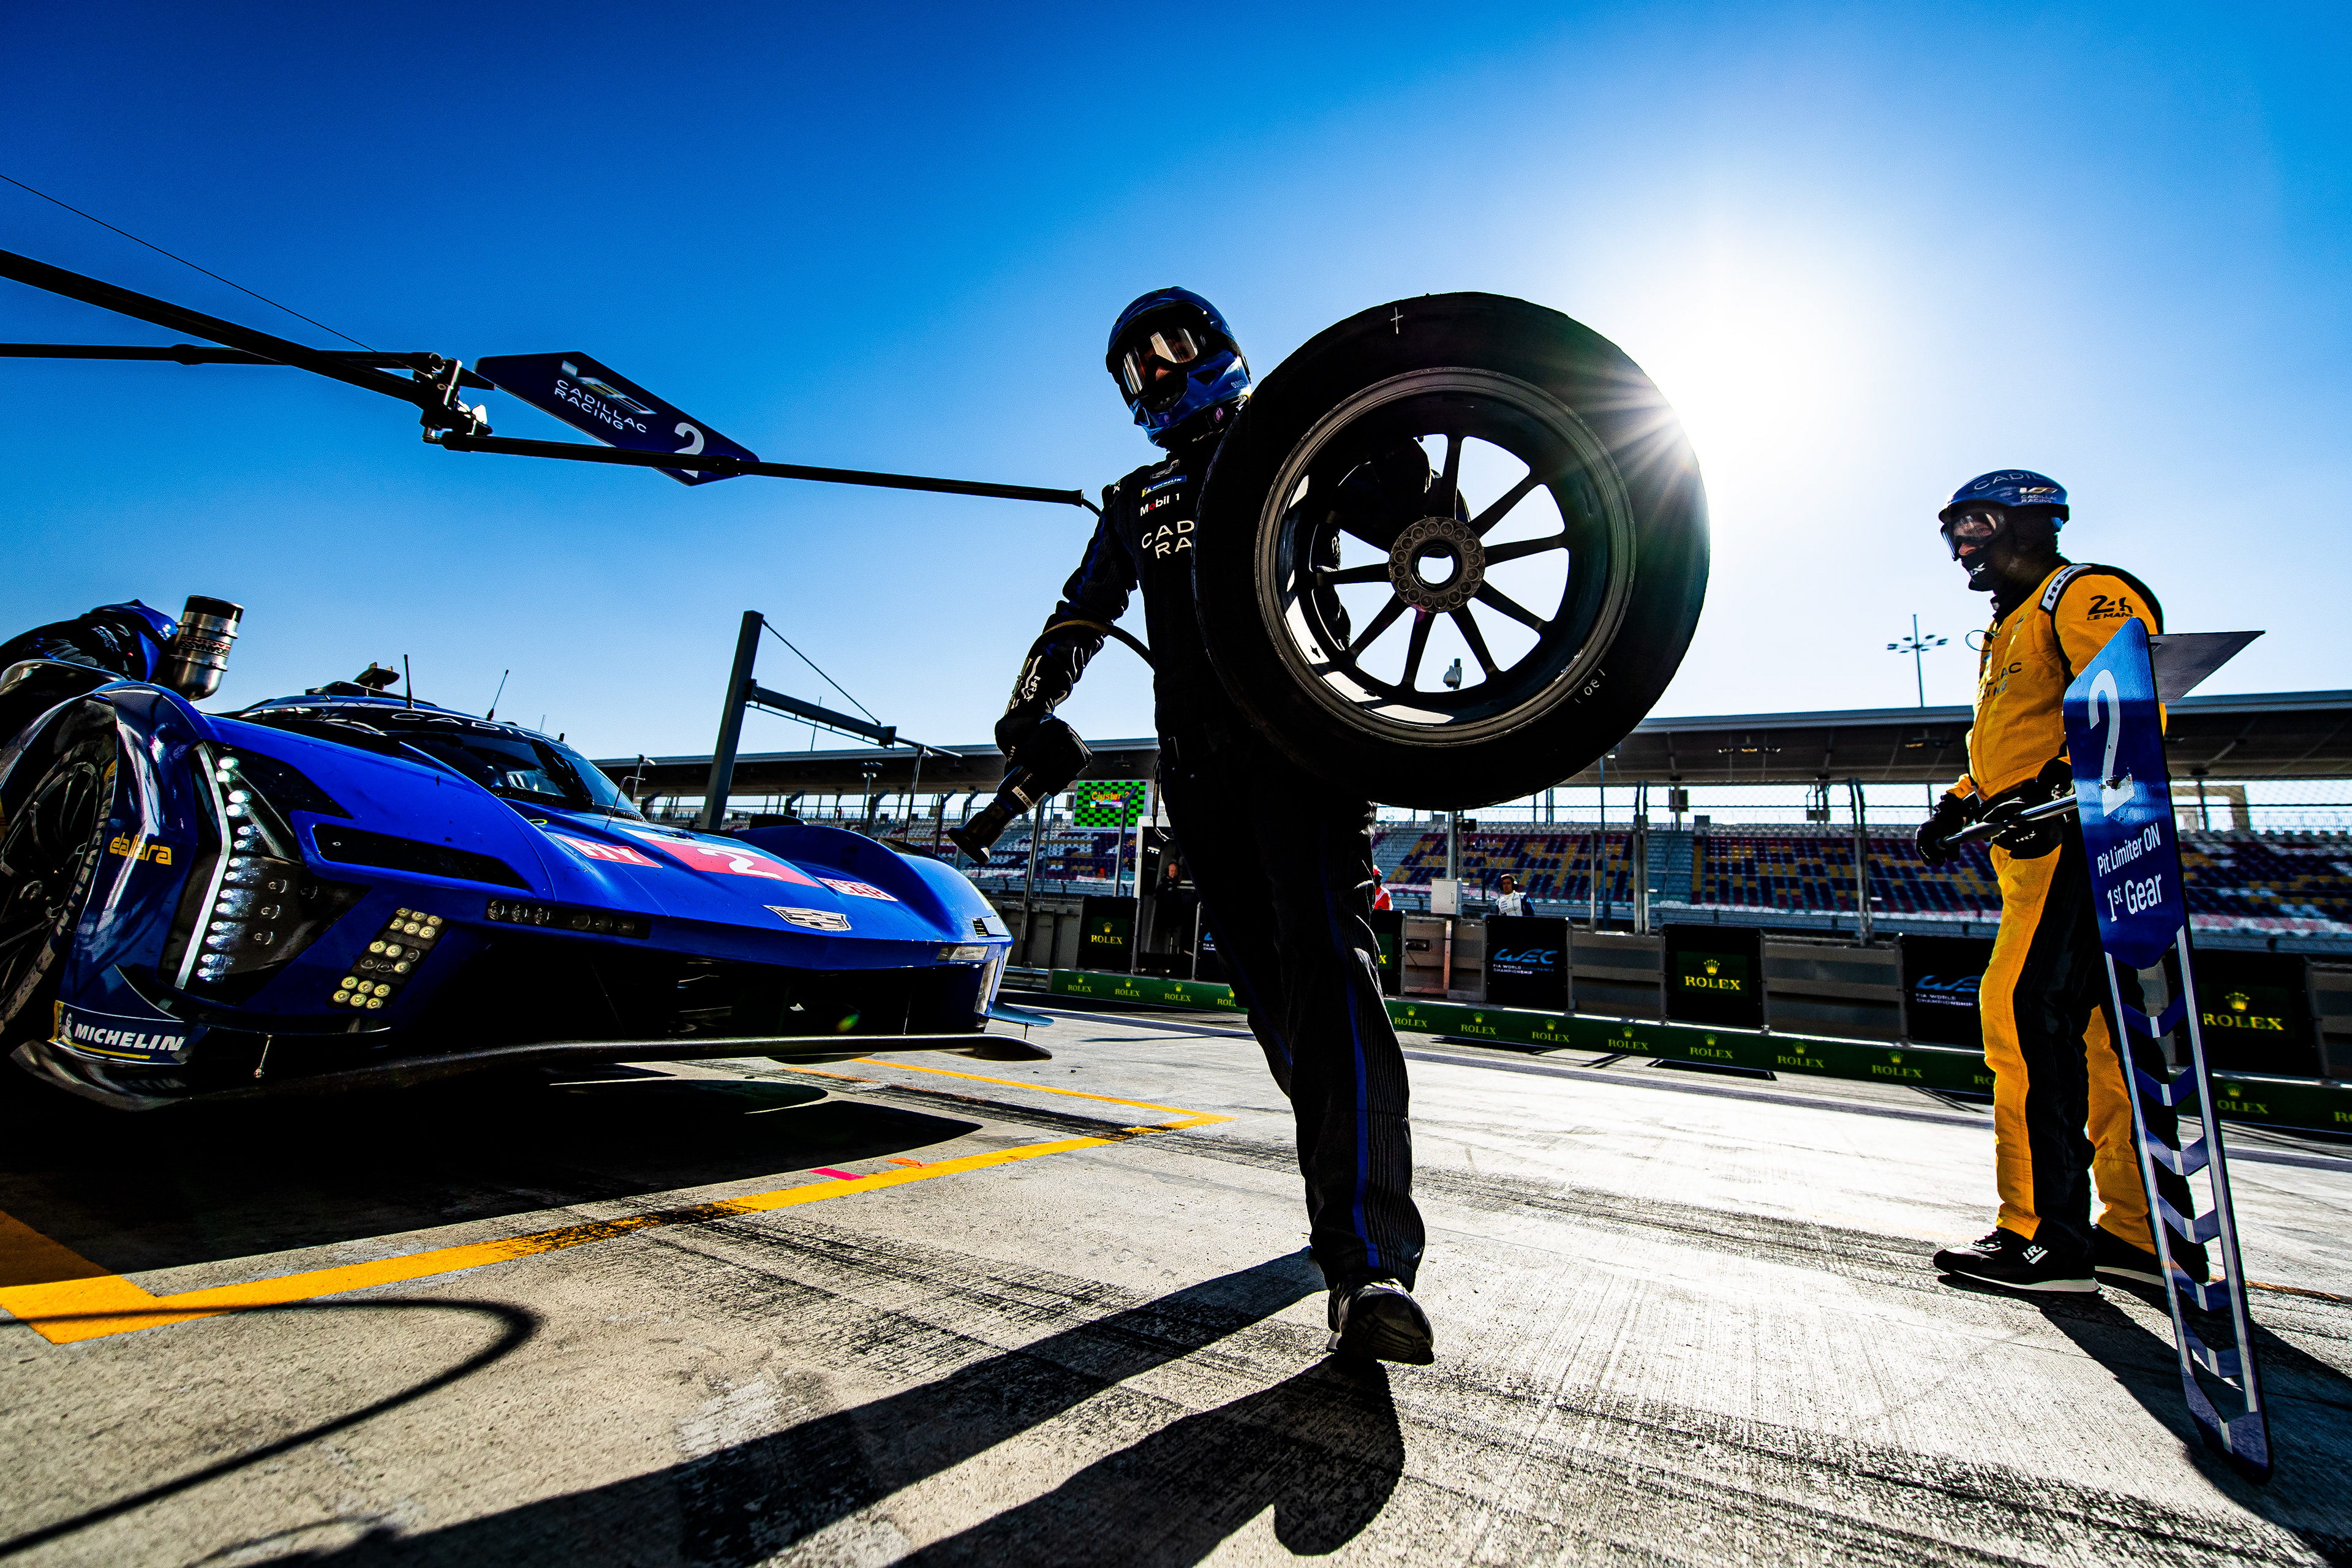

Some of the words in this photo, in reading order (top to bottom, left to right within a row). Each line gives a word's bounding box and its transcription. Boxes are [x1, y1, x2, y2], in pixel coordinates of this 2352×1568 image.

[554, 388, 624, 429] RACING
[556, 380, 647, 433] CADILLAC
[674, 422, 704, 478] 2
[1140, 495, 1170, 516] Mobil
[2088, 669, 2135, 817] 2
[1091, 791, 1121, 801] Cluster
[109, 832, 172, 865] dallara
[2097, 853, 2111, 877] Pit
[2109, 837, 2143, 870] Limiter
[2144, 823, 2161, 851] ON
[696, 848, 783, 880] 2
[2125, 873, 2162, 914] Gear
[1090, 934, 1123, 945] ROLEX
[1493, 948, 1558, 965] WEC
[1068, 984, 1092, 993] ROLEX
[1684, 976, 1741, 991] ROLEX
[1115, 988, 1140, 997] ROLEX
[1164, 993, 1191, 1002] ROLEX
[1916, 998, 1974, 1007] CHAMPIONSHIP
[1394, 1017, 1428, 1028] ROLEX
[1461, 1023, 1497, 1035] ROLEX
[2203, 1012, 2285, 1031] ROLEX
[74, 1022, 187, 1052] MICHELIN
[1532, 1031, 1570, 1042] ROLEX
[1607, 1038, 1649, 1051] ROLEX
[1689, 1046, 1733, 1060] ROLEX
[1777, 1055, 1825, 1069] ROLEX
[1871, 1064, 1923, 1079] ROLEX
[2216, 1099, 2270, 1115] OLEX
